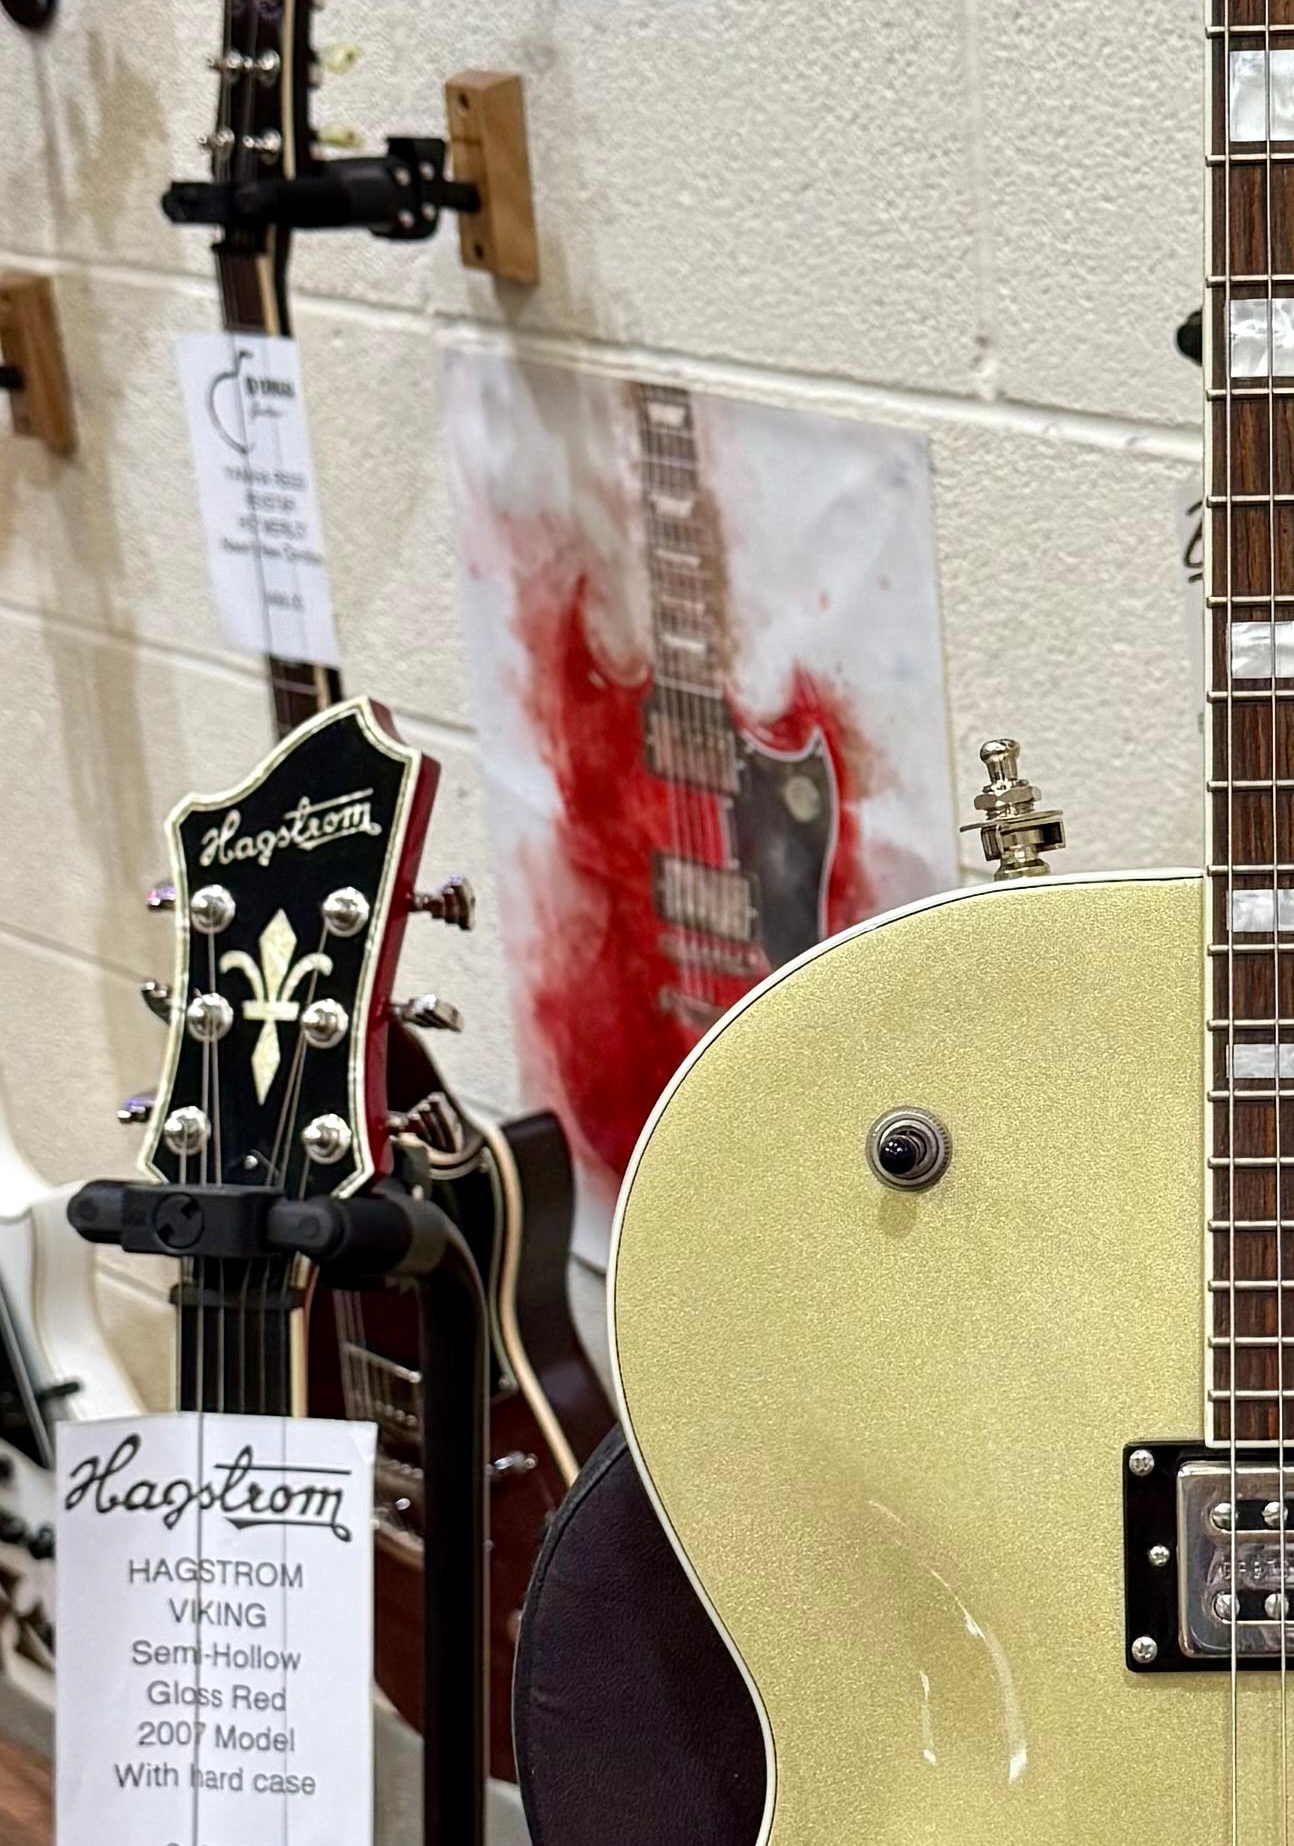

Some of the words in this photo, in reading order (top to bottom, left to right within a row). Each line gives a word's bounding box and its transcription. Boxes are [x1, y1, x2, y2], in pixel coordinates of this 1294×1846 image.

[199, 787, 383, 867] Hagstrom
[64, 1433, 352, 1542] Hagstrom
[128, 1557, 303, 1588] HAGSTROM
[169, 1597, 267, 1628] VIKING
[132, 1640, 301, 1671] Semi-Hollow
[147, 1680, 223, 1708] Gloss
[232, 1685, 286, 1711] Red
[138, 1721, 206, 1746] 2007
[215, 1725, 296, 1753] Model
[114, 1763, 180, 1789] With
[190, 1763, 243, 1792] hard
[253, 1772, 316, 1796] case
